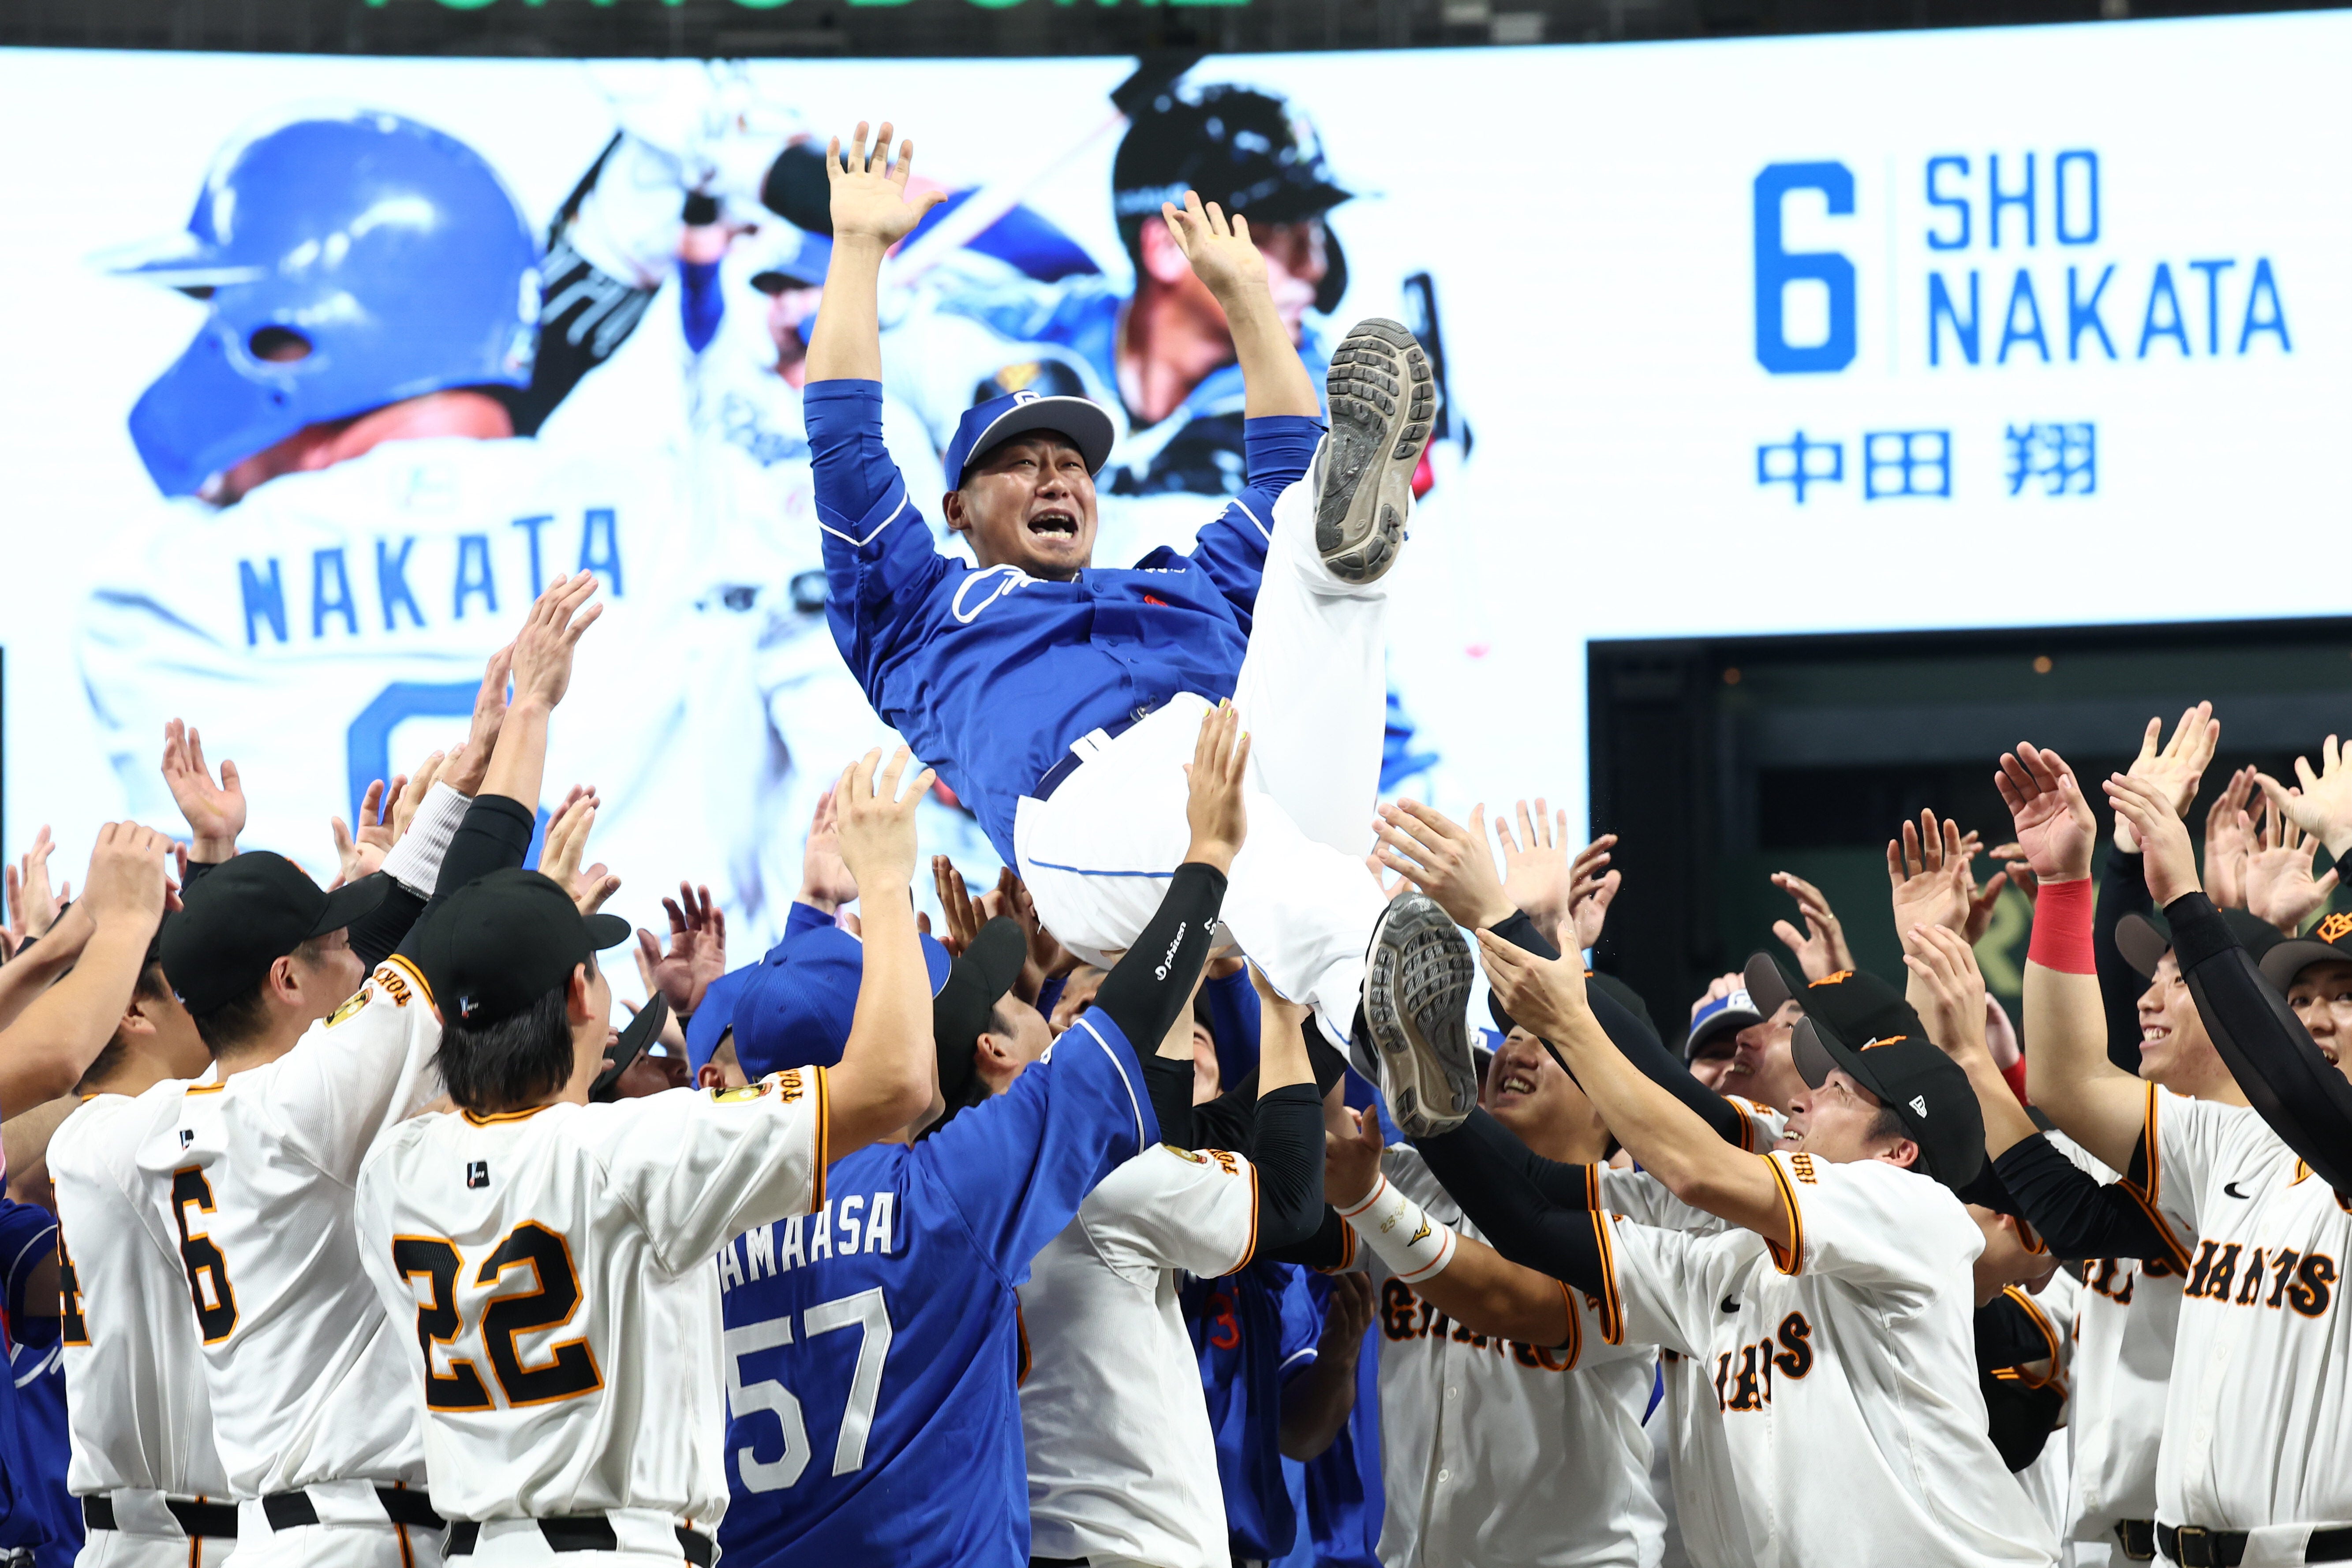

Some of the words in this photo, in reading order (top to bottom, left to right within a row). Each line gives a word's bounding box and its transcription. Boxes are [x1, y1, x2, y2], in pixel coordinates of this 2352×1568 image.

[1752, 159, 1858, 376] 6
[1926, 148, 2100, 252] SHO
[1928, 256, 2292, 367] NAKATA
[1756, 430, 1952, 505] 中田
[238, 507, 624, 646] NAKATA
[1164, 921, 1187, 970] phiten
[170, 1164, 240, 1346] 6
[392, 1218, 605, 1412] 22
[723, 1285, 893, 1494] 57
